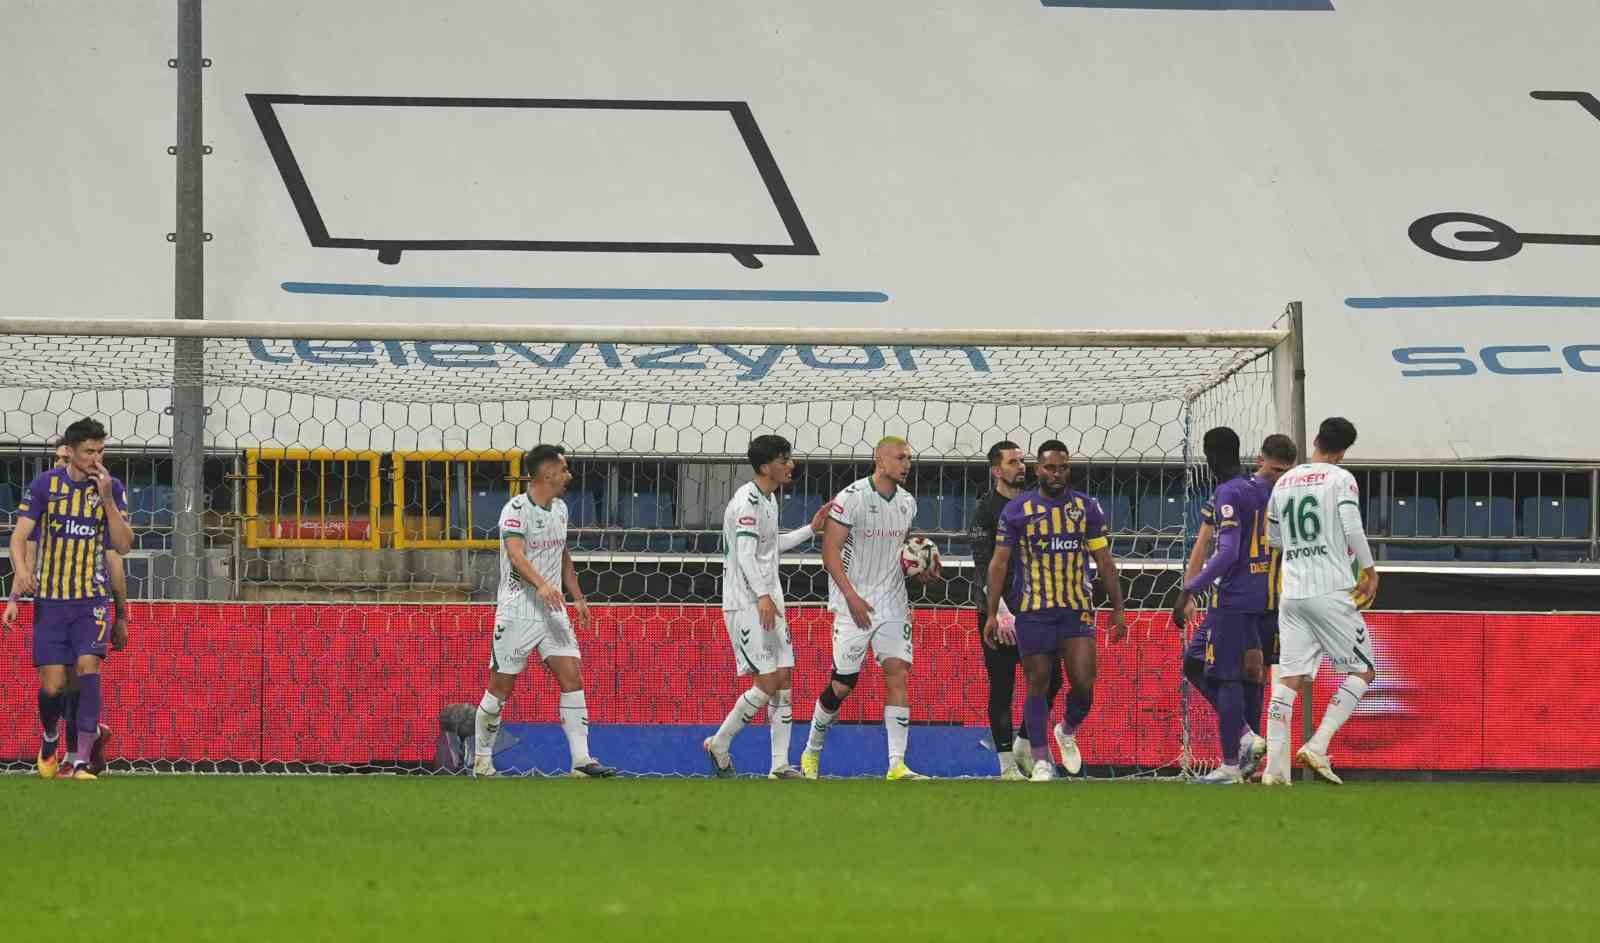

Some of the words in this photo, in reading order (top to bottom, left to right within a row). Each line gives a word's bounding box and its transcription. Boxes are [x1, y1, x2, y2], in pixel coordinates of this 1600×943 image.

[65, 520, 97, 536] ikas
[1282, 494, 1321, 544] 16
[1051, 537, 1079, 551] ikas
[95, 620, 107, 641] 7
